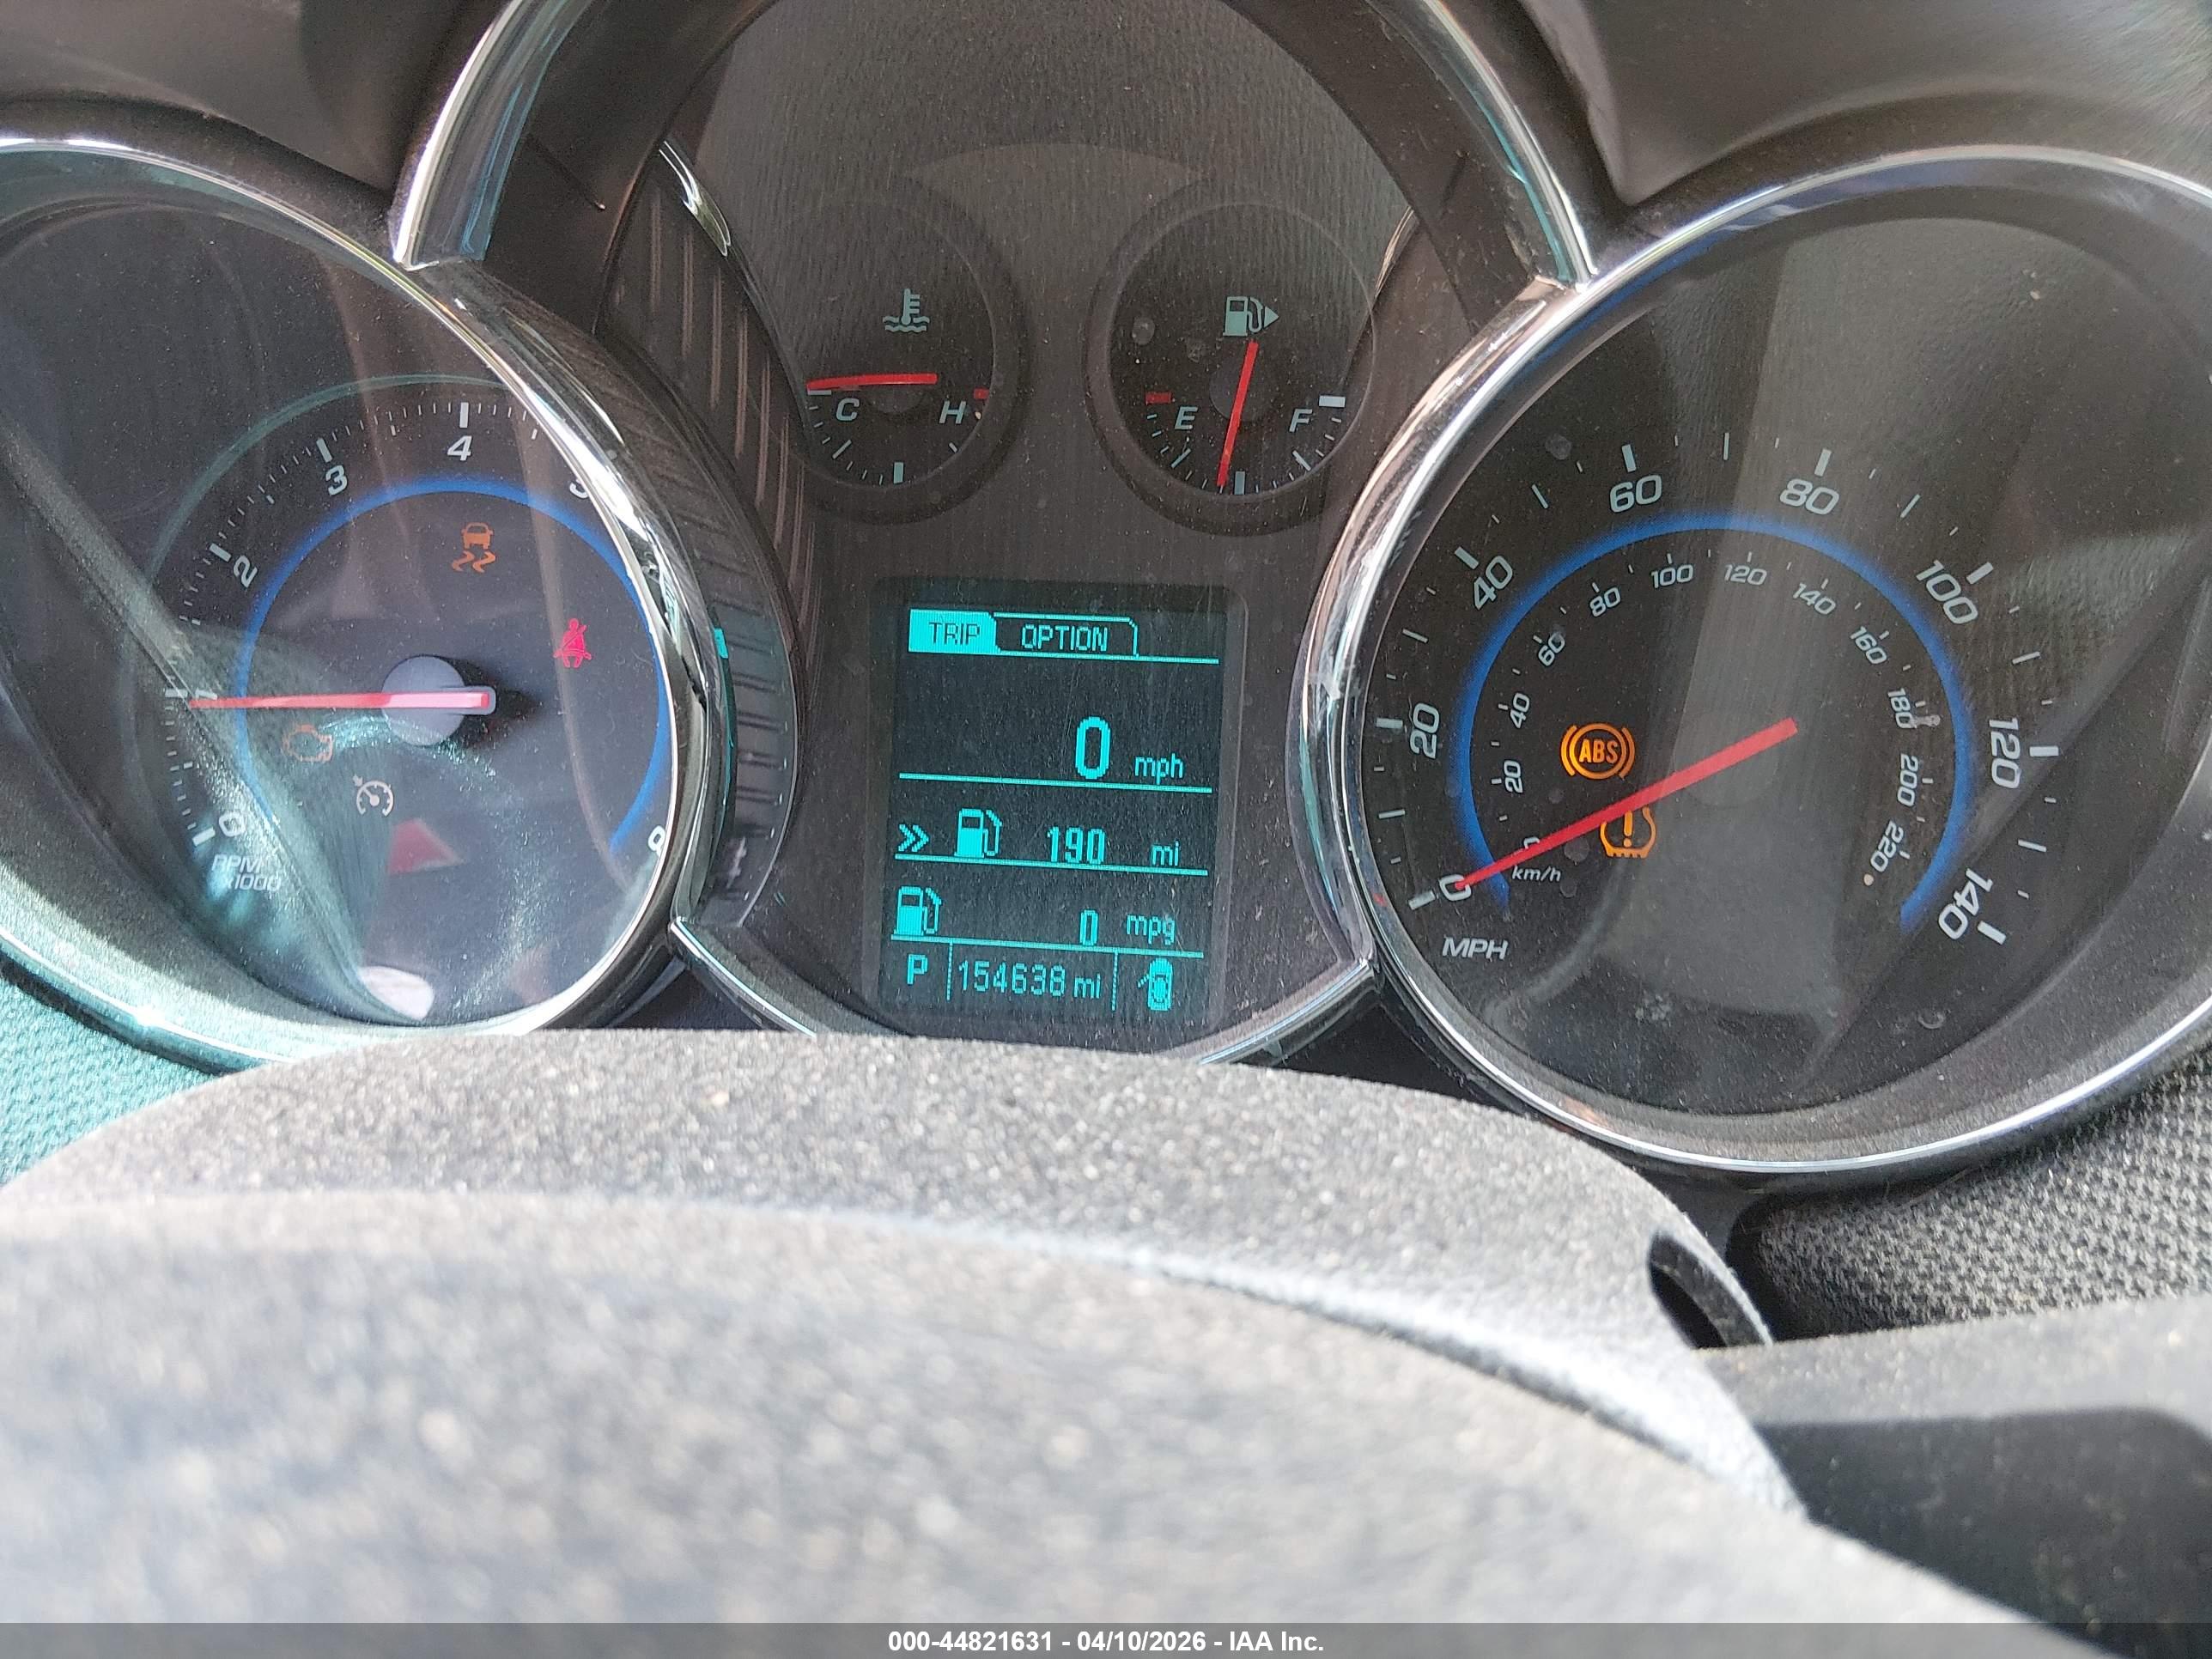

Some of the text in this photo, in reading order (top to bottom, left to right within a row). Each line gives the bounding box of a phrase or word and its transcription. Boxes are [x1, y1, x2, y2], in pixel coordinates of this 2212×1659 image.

[836, 398, 860, 422] C
[939, 400, 968, 425] H
[1175, 406, 1200, 430] E
[1289, 408, 1313, 433] F
[447, 435, 472, 462] 4
[325, 467, 349, 496] 3
[1609, 474, 1662, 513] 60
[1779, 478, 1839, 514] 80
[233, 560, 258, 587] 2
[1473, 556, 1513, 610] 40
[1651, 564, 1693, 588] 100
[1723, 563, 1767, 586] 120
[1589, 586, 1621, 617] 80
[1792, 582, 1836, 615] 140
[1916, 559, 1978, 624] 100
[929, 621, 980, 645] TRIP
[1021, 623, 1109, 652] OPTION
[1849, 626, 1887, 665] 160
[1538, 635, 1565, 666] 60
[1510, 692, 1531, 729] 40
[1887, 687, 1912, 730] 180
[1410, 702, 1440, 759] 20
[1075, 717, 1183, 786] 0 mph
[1578, 739, 1620, 765] ABS
[1988, 717, 2021, 788] 120
[1504, 760, 1523, 793] 20
[1897, 752, 1919, 806] 200
[218, 812, 246, 838] 0
[1047, 826, 1181, 866] 190 mi
[1870, 821, 1905, 872] 220
[1439, 874, 1472, 902] 0
[1511, 864, 1562, 882] km/h
[1938, 867, 1994, 939] 140
[1079, 910, 1176, 945] 0 mpg
[1442, 936, 1509, 960] MPH
[907, 954, 928, 985] P
[957, 961, 1102, 999] 154638 mi
